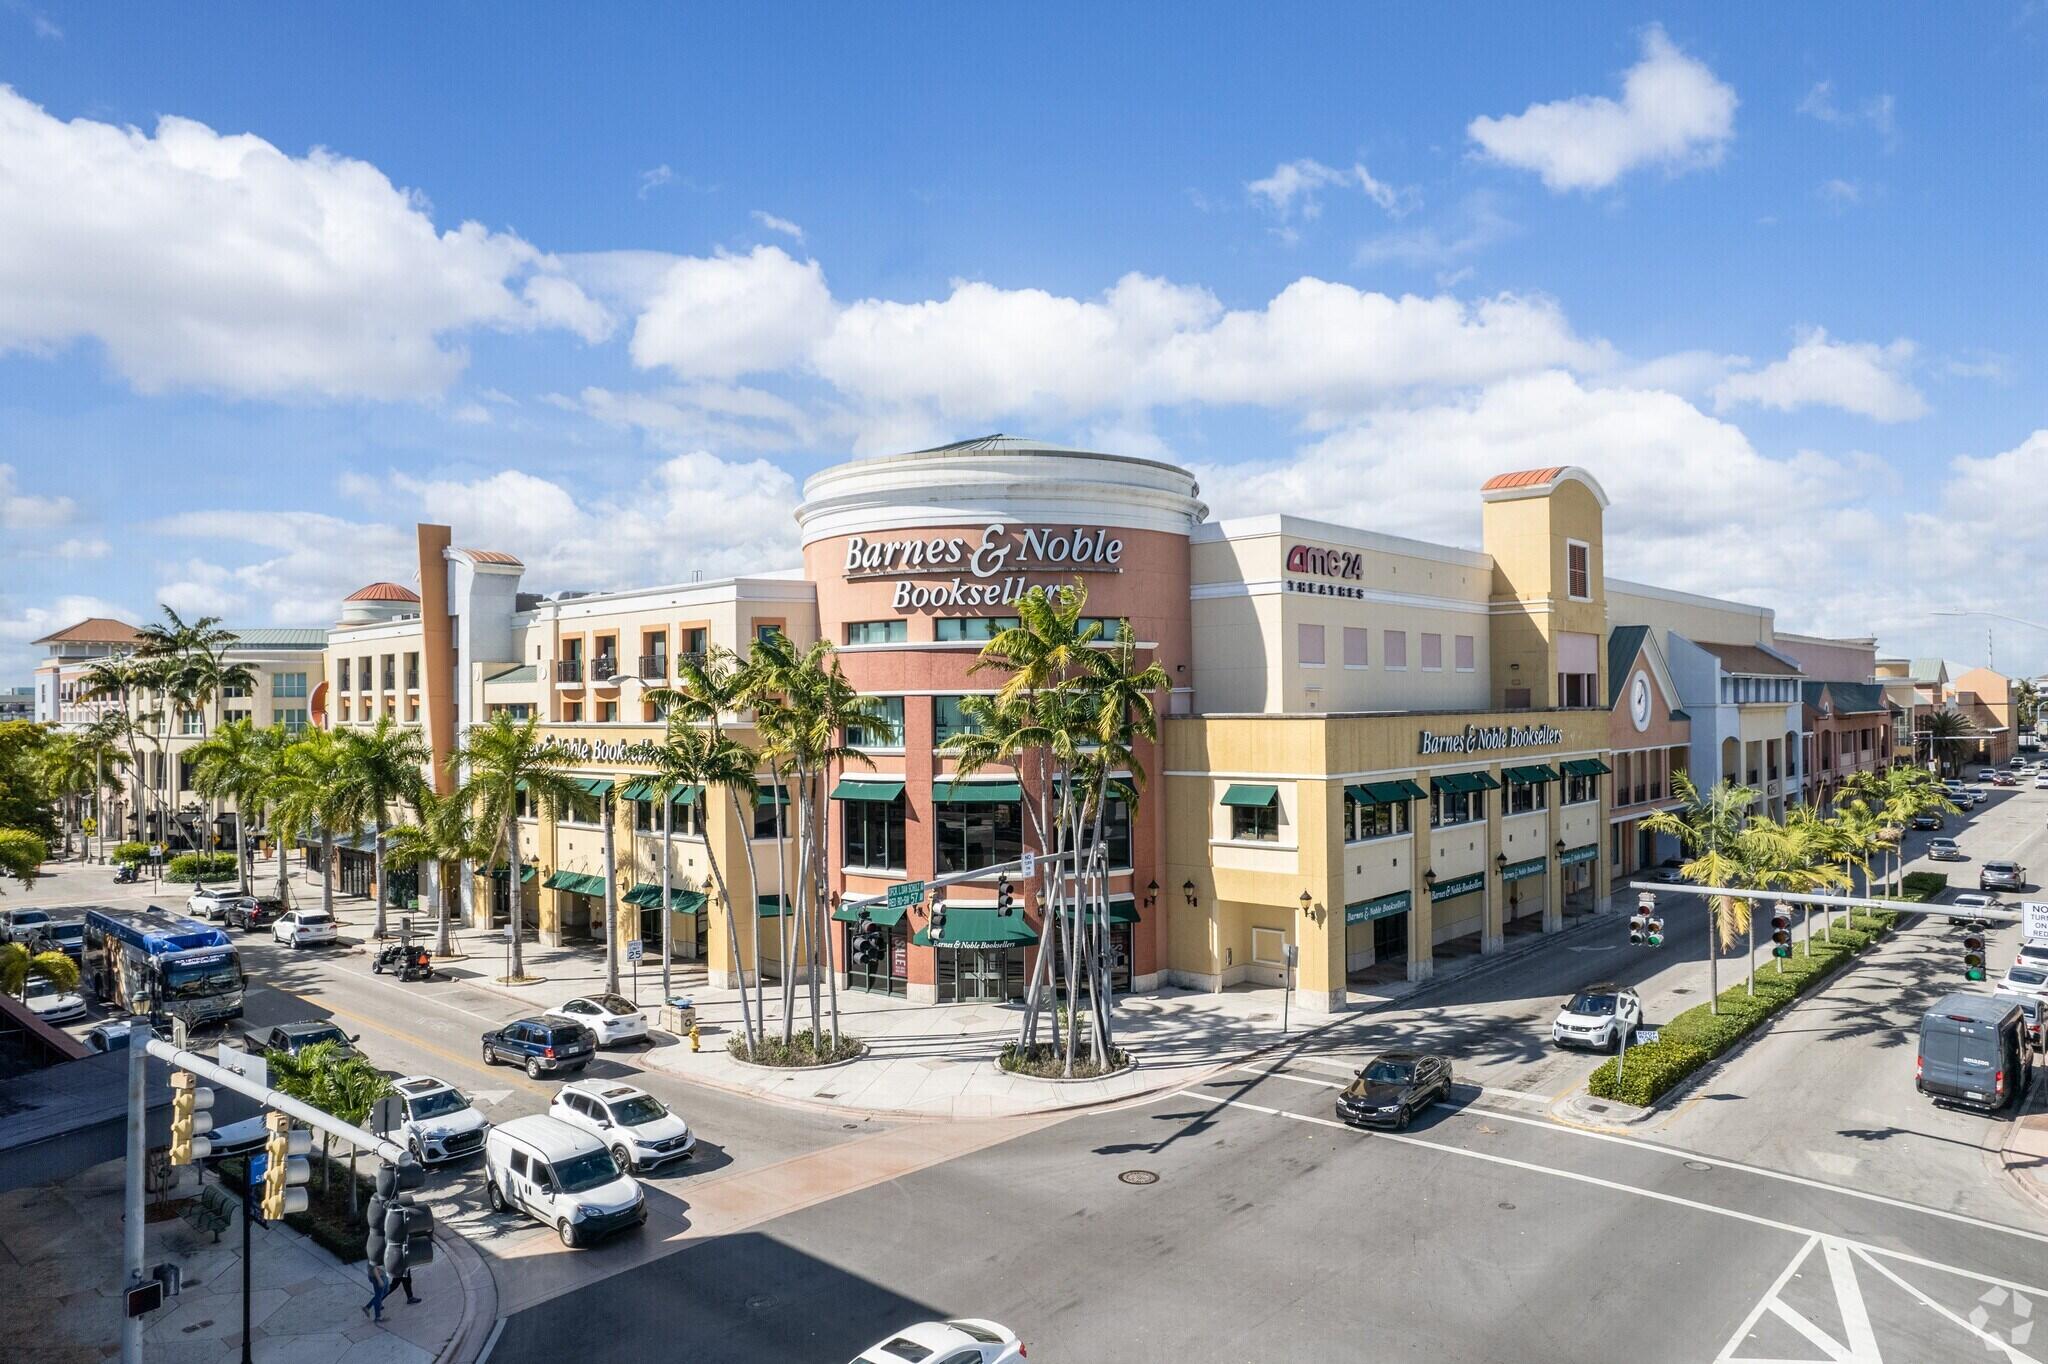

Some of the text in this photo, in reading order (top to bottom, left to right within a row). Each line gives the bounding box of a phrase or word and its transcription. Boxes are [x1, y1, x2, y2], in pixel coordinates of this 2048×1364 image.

[843, 523, 1123, 578] Barnes & Noble
[1341, 552, 1364, 580] 24
[1287, 581, 1364, 599] THEATRES
[1422, 724, 1562, 754] Barnes & Noble Booksellers
[911, 892, 919, 905] 57
[1347, 900, 1406, 921] Barnes & Noble Booksellers
[2032, 905, 2048, 913] NO
[895, 940, 906, 966] SALE
[954, 940, 961, 949] &
[980, 941, 1015, 949] Booksellers
[628, 950, 641, 960] 25
